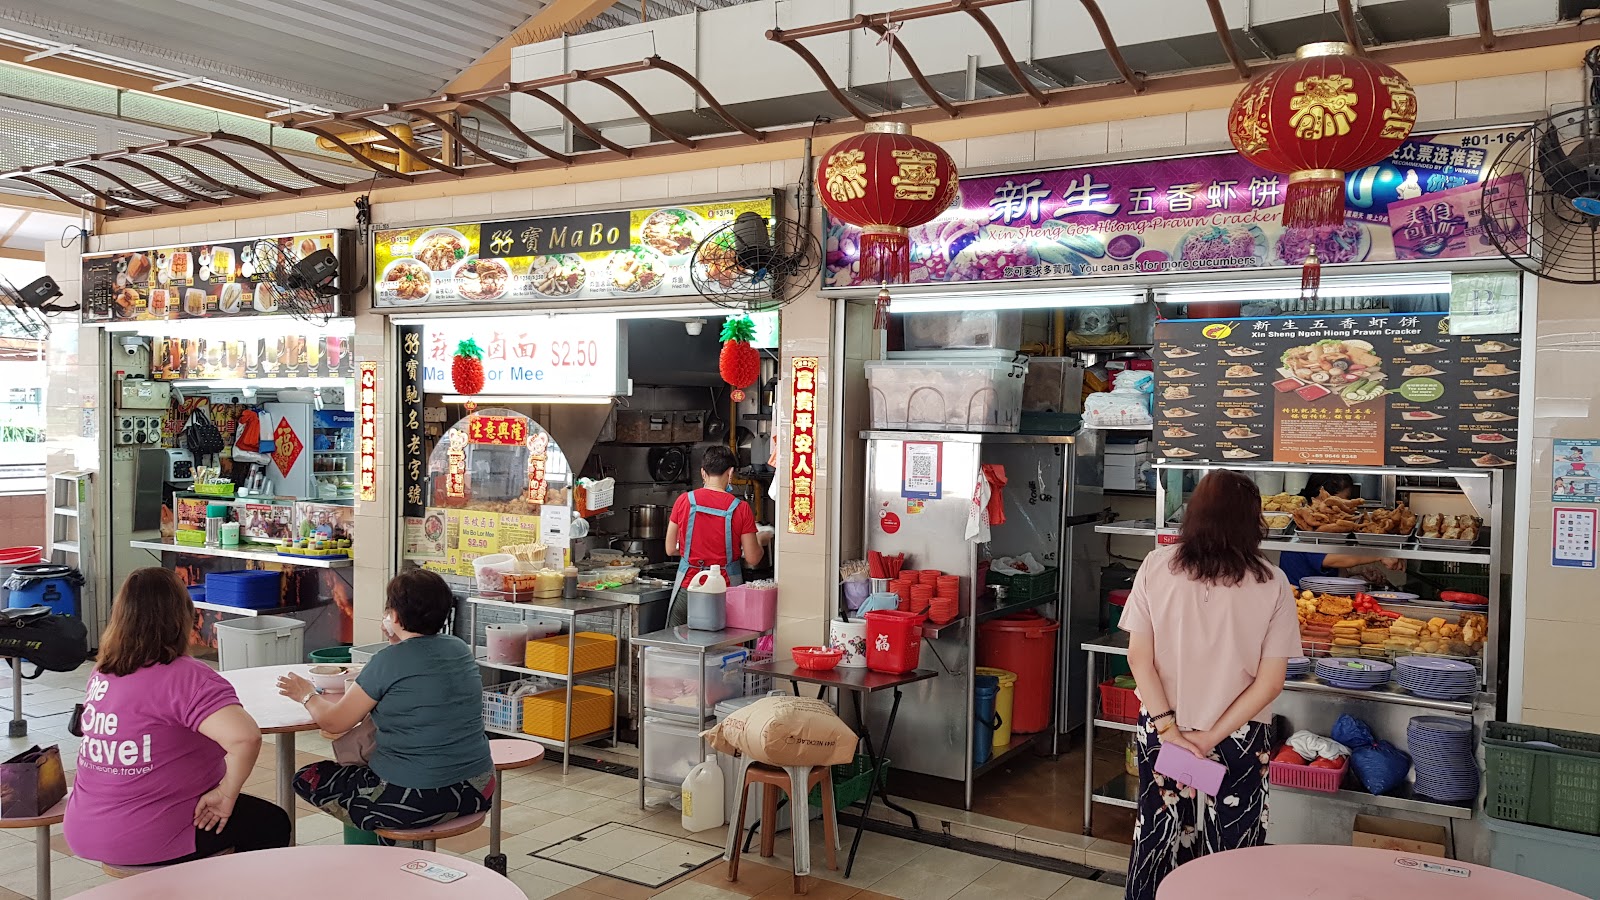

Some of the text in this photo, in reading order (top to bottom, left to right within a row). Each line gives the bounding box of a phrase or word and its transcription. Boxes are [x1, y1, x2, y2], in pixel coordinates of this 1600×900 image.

[1391, 160, 1437, 169] RECOMMENDED
[989, 173, 1281, 225] 新生 五香虾饼
[988, 208, 1282, 241] Xin Sheng Gor Hiong Prawn Cracker
[549, 222, 620, 250] MaBo
[1079, 264, 1098, 275] You
[1100, 264, 1120, 272] can
[1122, 259, 1141, 270] ask
[1143, 260, 1159, 269] for
[1161, 260, 1189, 269] more
[1192, 256, 1256, 268] cucumbers
[1472, 289, 1495, 316] B
[1252, 316, 1420, 331] 新生五香虾饼
[1268, 331, 1296, 339] Sheng
[1298, 330, 1322, 338] Ngoh
[1324, 329, 1350, 338] Hiong
[1353, 328, 1382, 336] Prawn
[1384, 328, 1422, 336] Cracker
[423, 367, 445, 381] Ma
[510, 366, 544, 381] Mee
[472, 420, 524, 441] 生意興隆
[275, 426, 294, 457] 福
[468, 538, 487, 548] $2.50
[874, 633, 890, 652] 福
[81, 703, 119, 736] One
[80, 734, 152, 766] ravel
